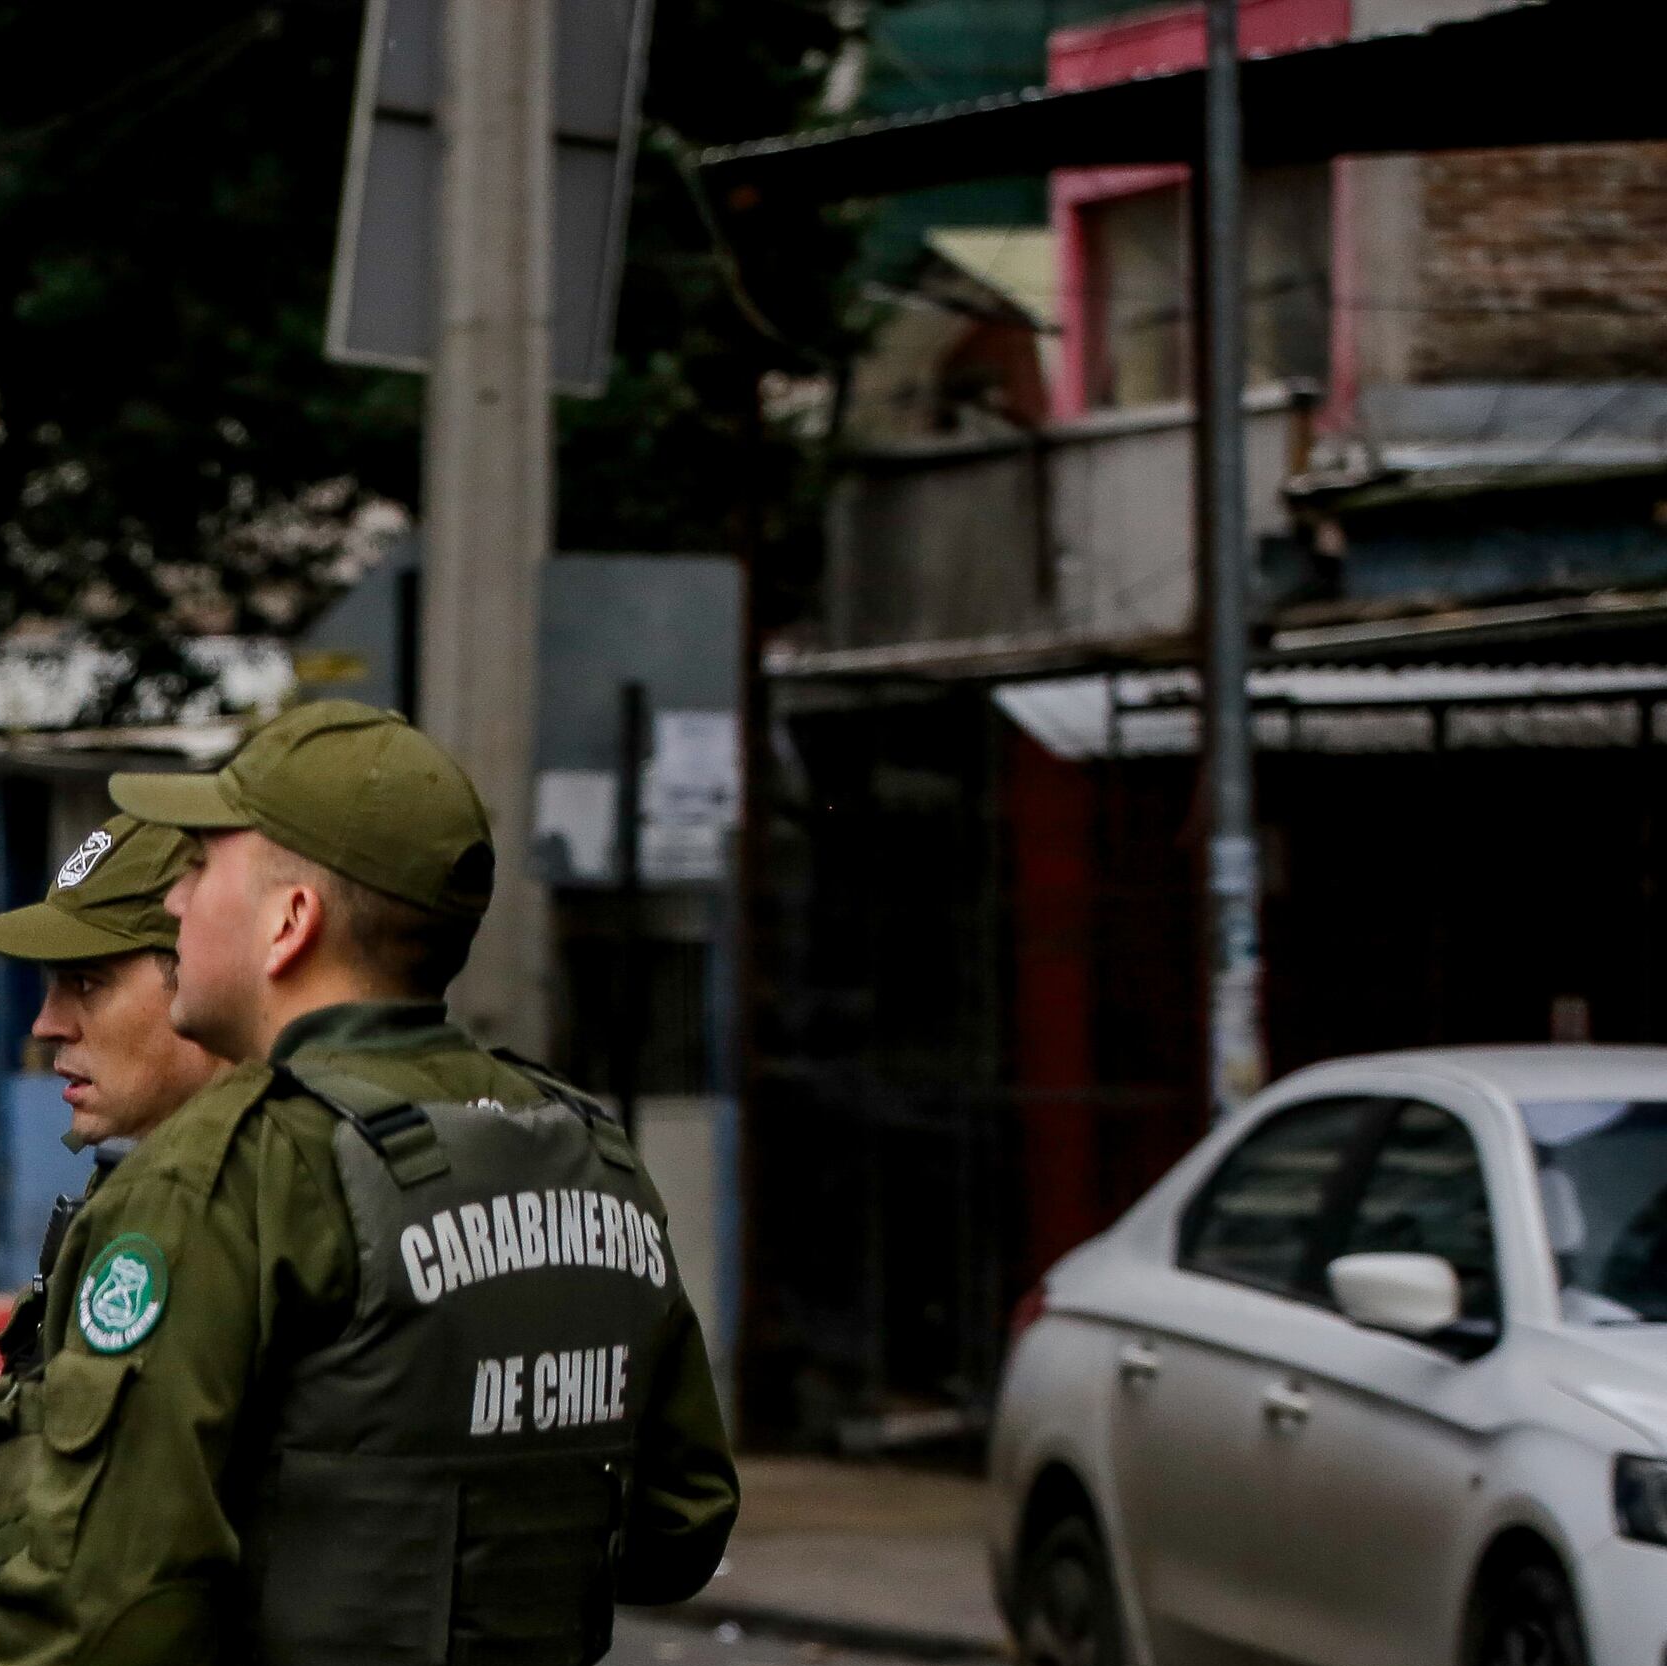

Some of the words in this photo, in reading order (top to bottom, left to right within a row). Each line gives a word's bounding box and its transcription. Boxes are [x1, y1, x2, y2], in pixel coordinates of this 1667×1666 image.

[400, 1188, 667, 1304] CARABINEROS
[470, 1354, 524, 1436] DE
[533, 1344, 630, 1432] CHILE
